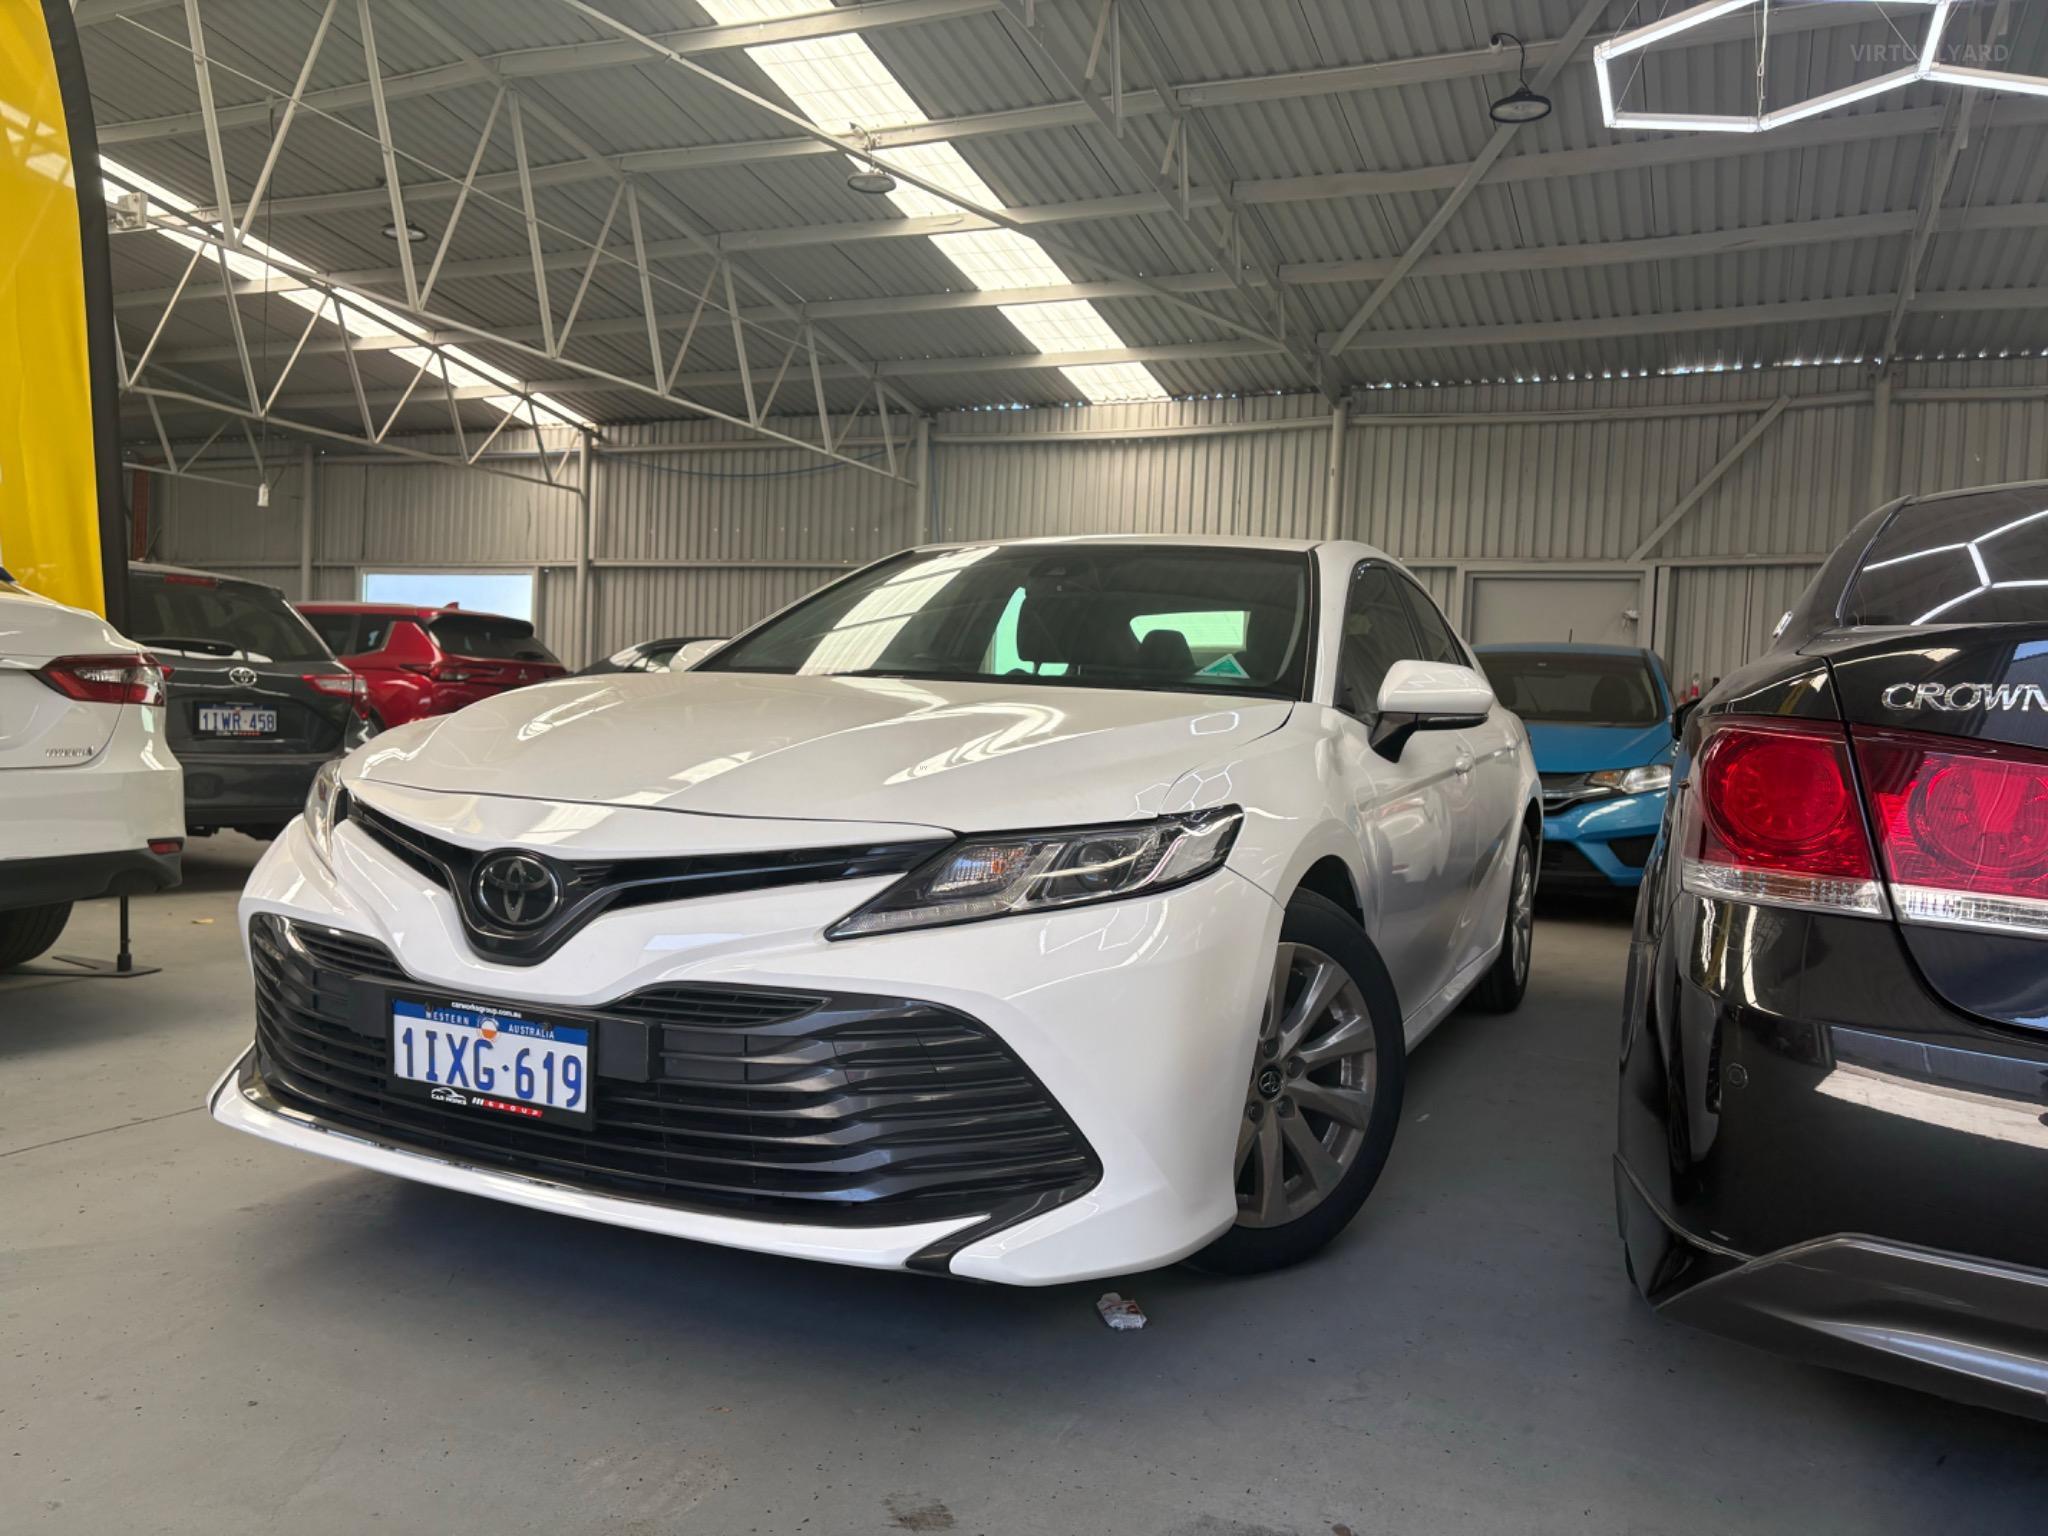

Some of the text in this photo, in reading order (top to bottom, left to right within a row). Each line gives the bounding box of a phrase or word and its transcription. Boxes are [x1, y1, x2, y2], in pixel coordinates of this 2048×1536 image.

[1881, 681, 2048, 711] CROWN
[425, 1011, 555, 1040] WESTERN AUSTRALIA
